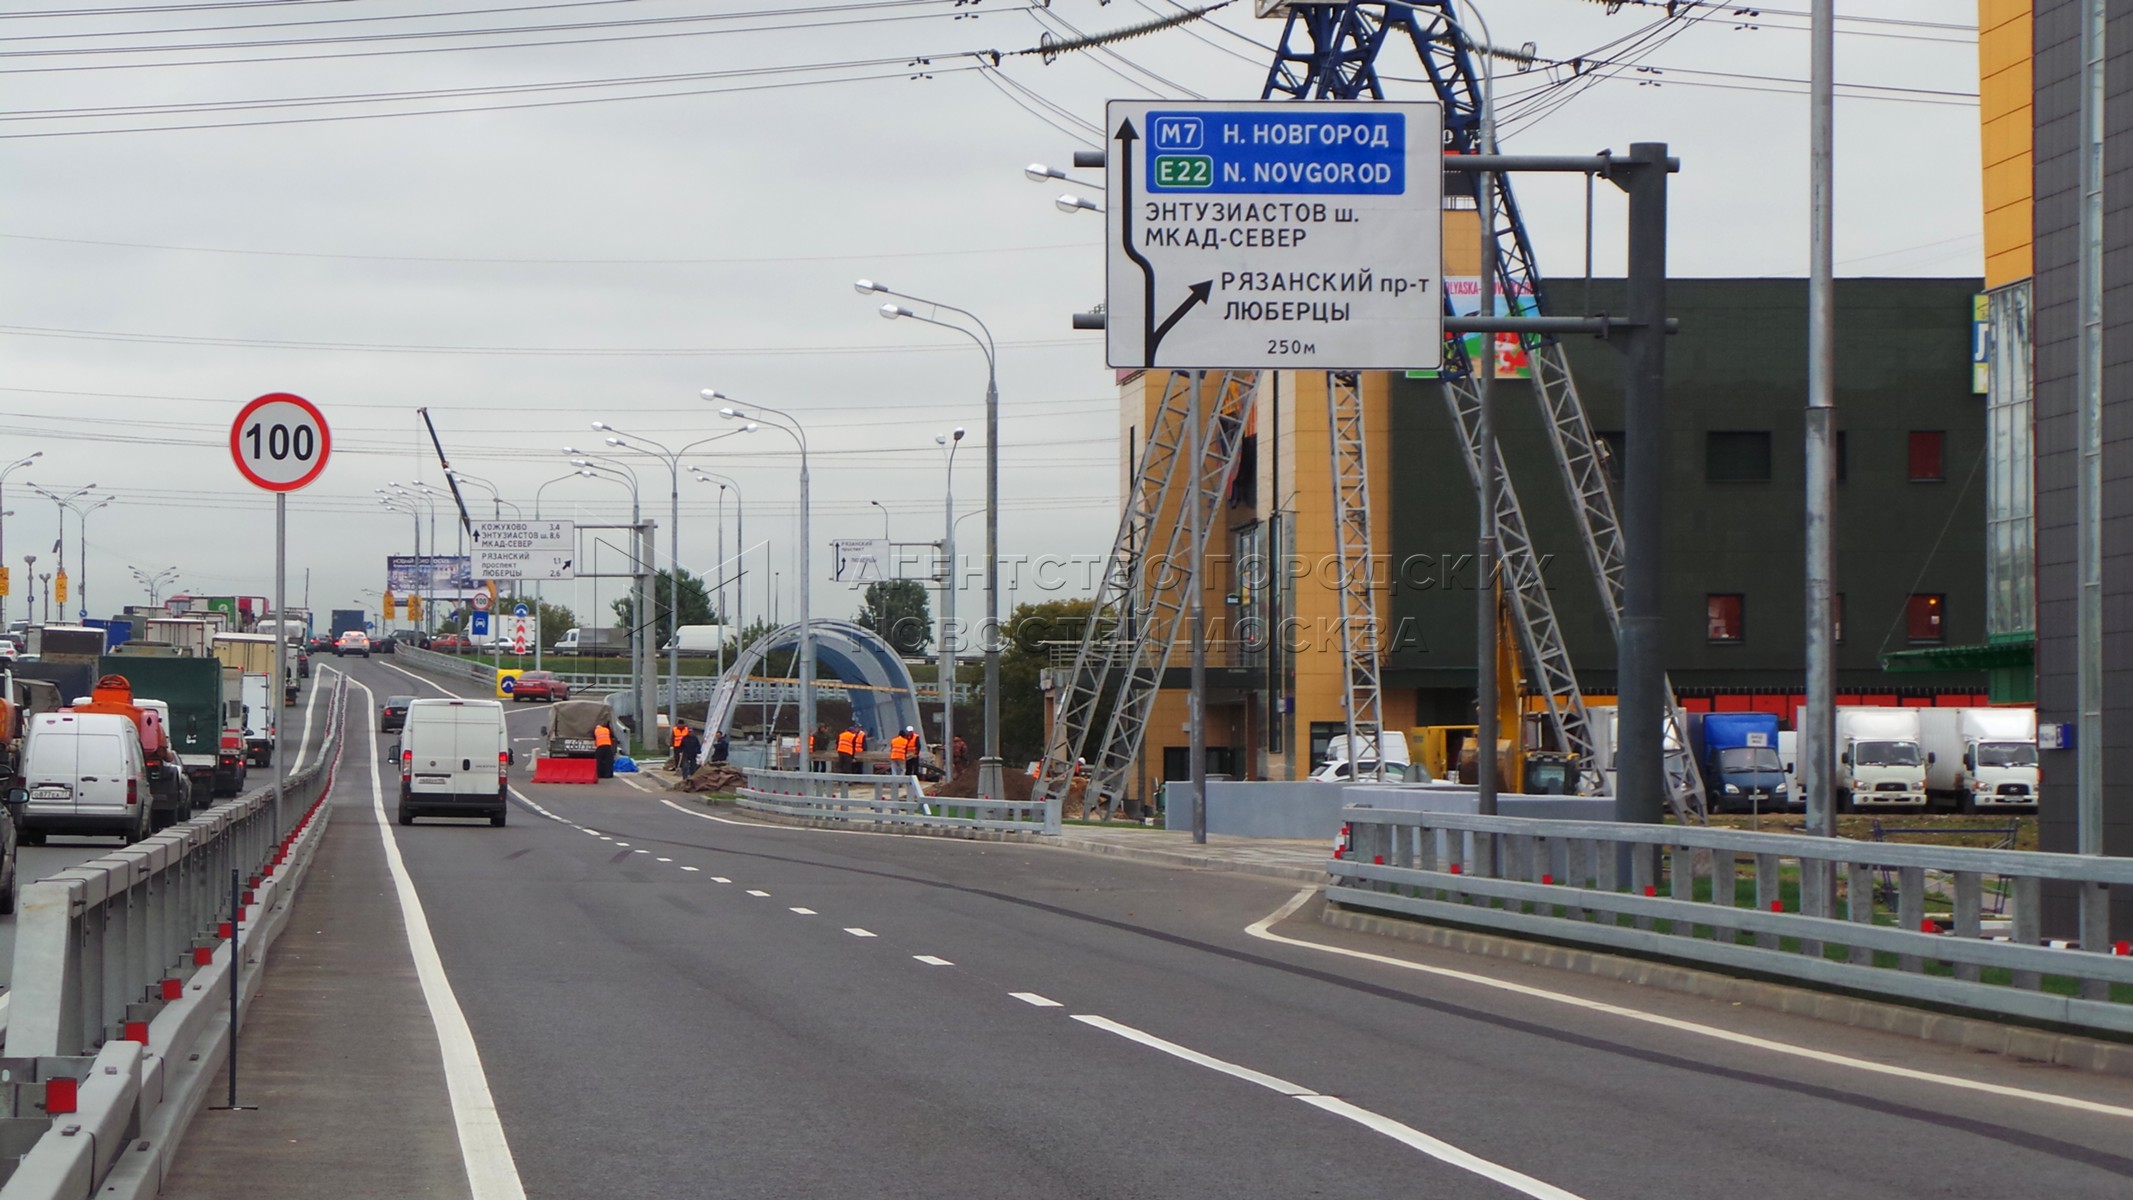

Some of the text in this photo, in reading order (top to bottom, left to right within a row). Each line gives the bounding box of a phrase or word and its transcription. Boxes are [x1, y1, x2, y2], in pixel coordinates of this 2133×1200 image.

[1161, 123, 1389, 148] М7 Н. НОВГОРОД
[1160, 161, 1391, 184] E22 N. NOVGOROD
[1145, 202, 1359, 223] ЭНТУЗИАСТОВ ш.
[1145, 228, 1307, 250] МКАД-СЕВЕР
[1221, 269, 1429, 297] РЯЗАНСКИЙ пр-т
[1224, 301, 1350, 323] ЛЮБЕРЦЫ
[1267, 340, 1315, 355] 250м
[246, 423, 314, 460] 100
[481, 523, 527, 531] КОЖУХОВО
[481, 540, 532, 548] МКАД-СЕВЕР
[481, 552, 530, 560] РЯЗАНСКИЙ
[482, 569, 522, 577] ЛЮБЕРЦЫ
